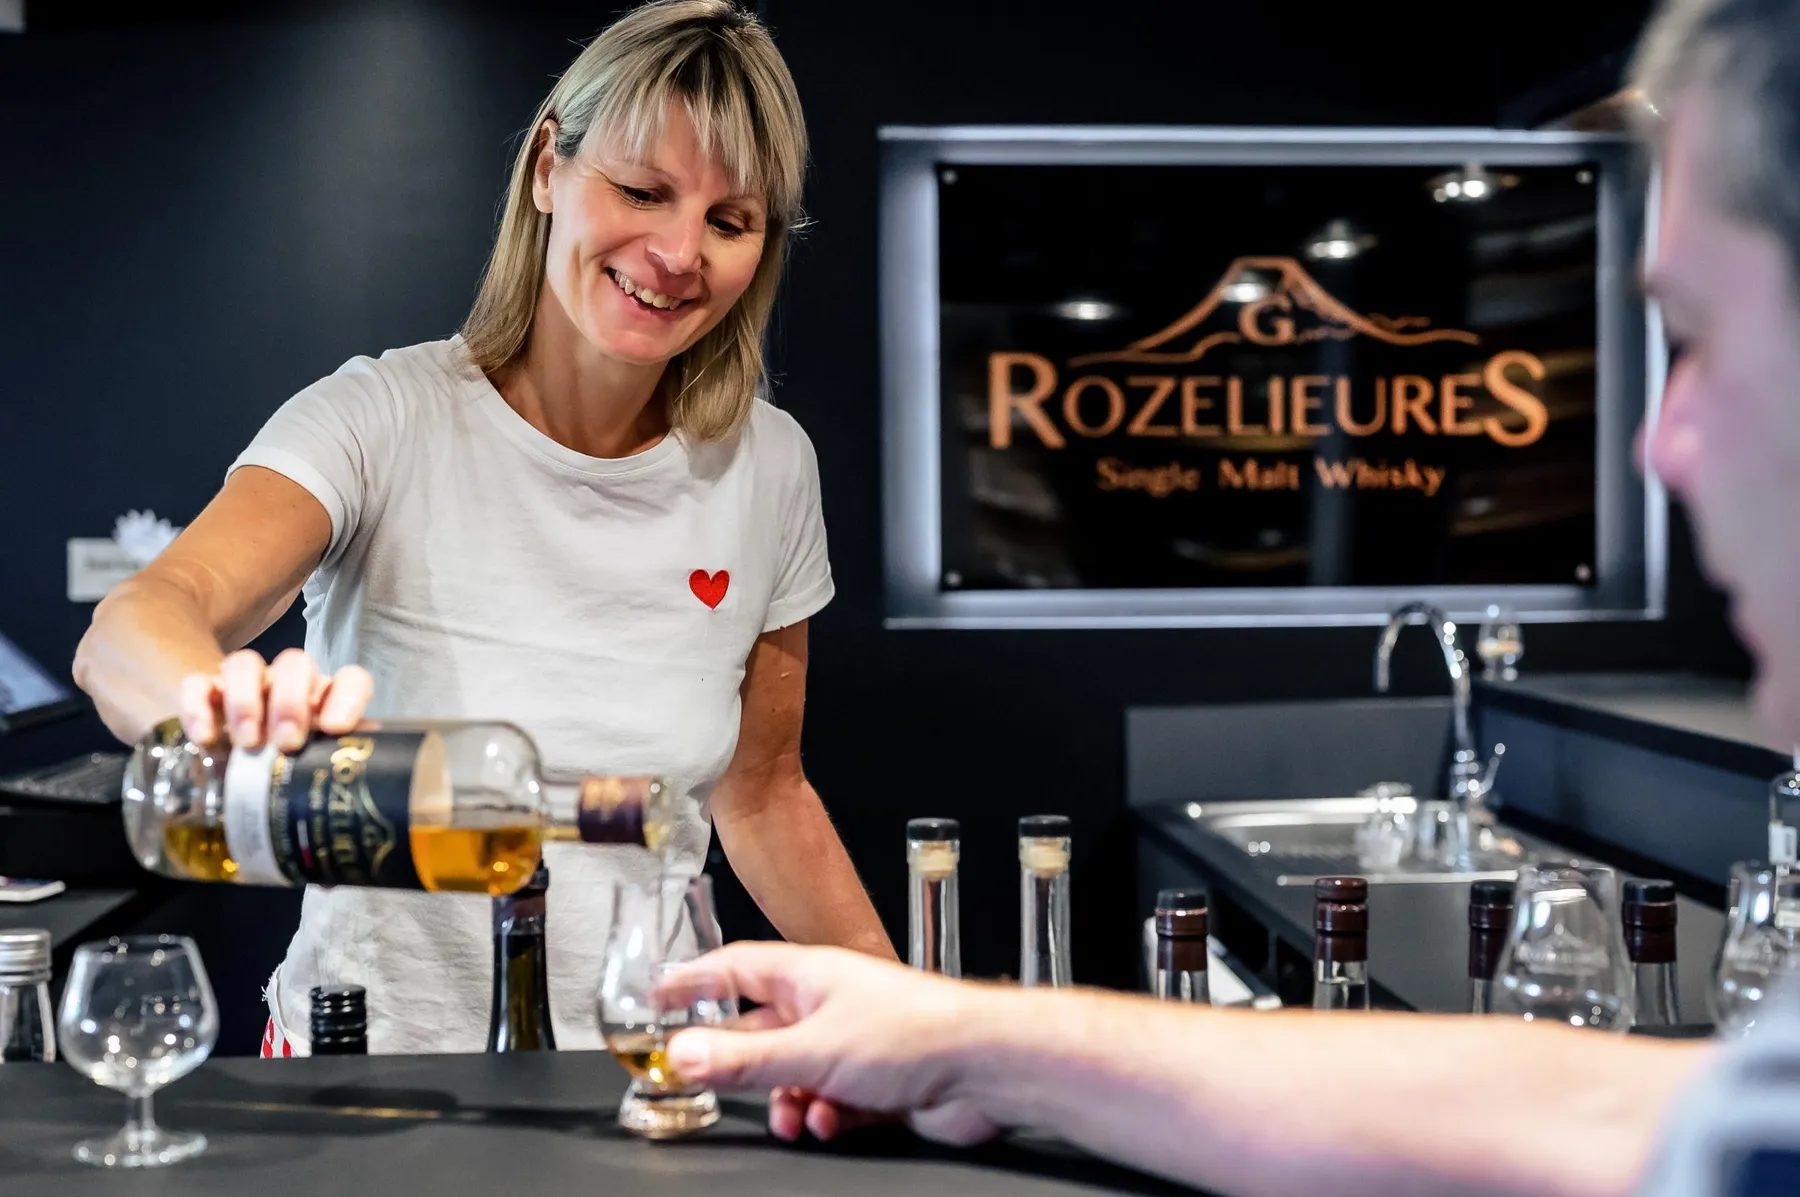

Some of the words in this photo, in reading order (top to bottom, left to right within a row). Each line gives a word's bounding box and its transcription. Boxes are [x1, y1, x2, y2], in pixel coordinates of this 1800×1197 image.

[988, 350, 1549, 449] ROZELIEURES
[1096, 457, 1200, 497] Single
[1218, 457, 1299, 490] Malt
[1314, 457, 1446, 497] Whisky
